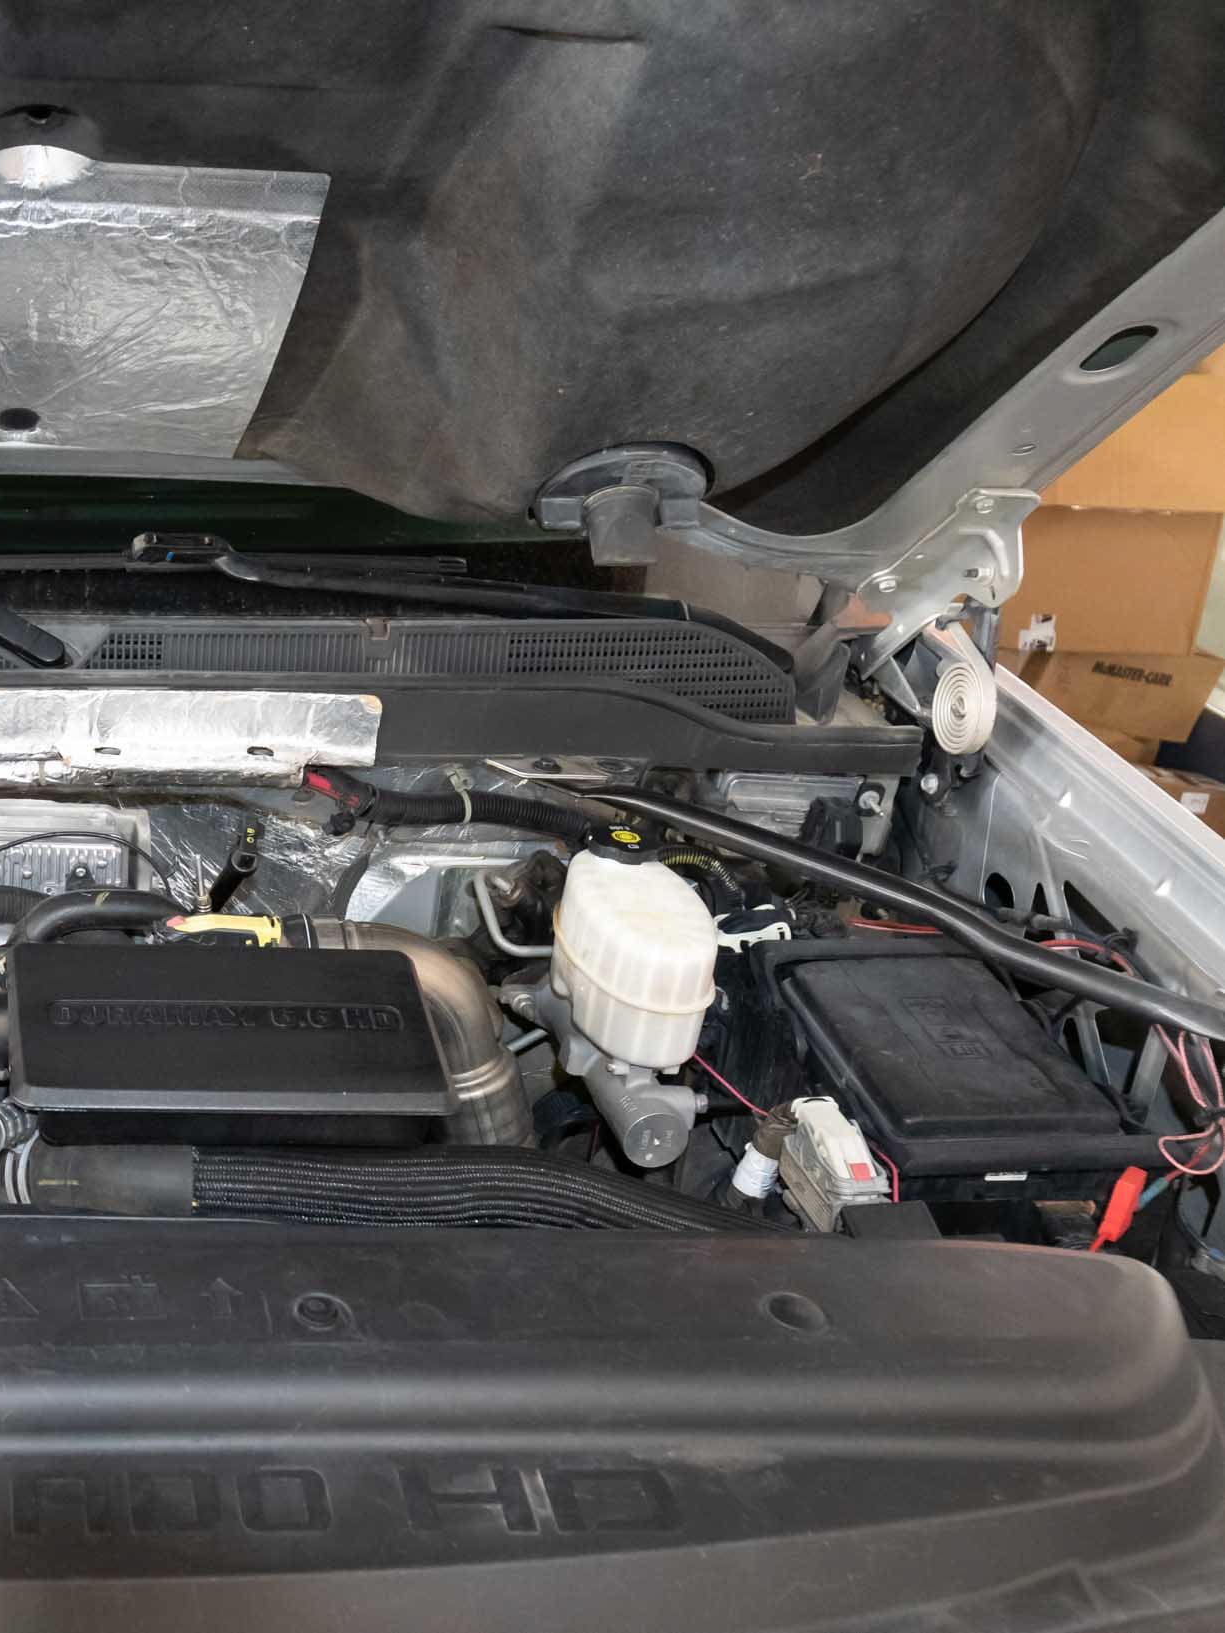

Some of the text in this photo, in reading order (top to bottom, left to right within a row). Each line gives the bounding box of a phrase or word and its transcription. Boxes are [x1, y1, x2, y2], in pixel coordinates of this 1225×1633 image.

[54, 1003, 400, 1030] DURAMAX 6.6 HD
[396, 1467, 683, 1537] HD
